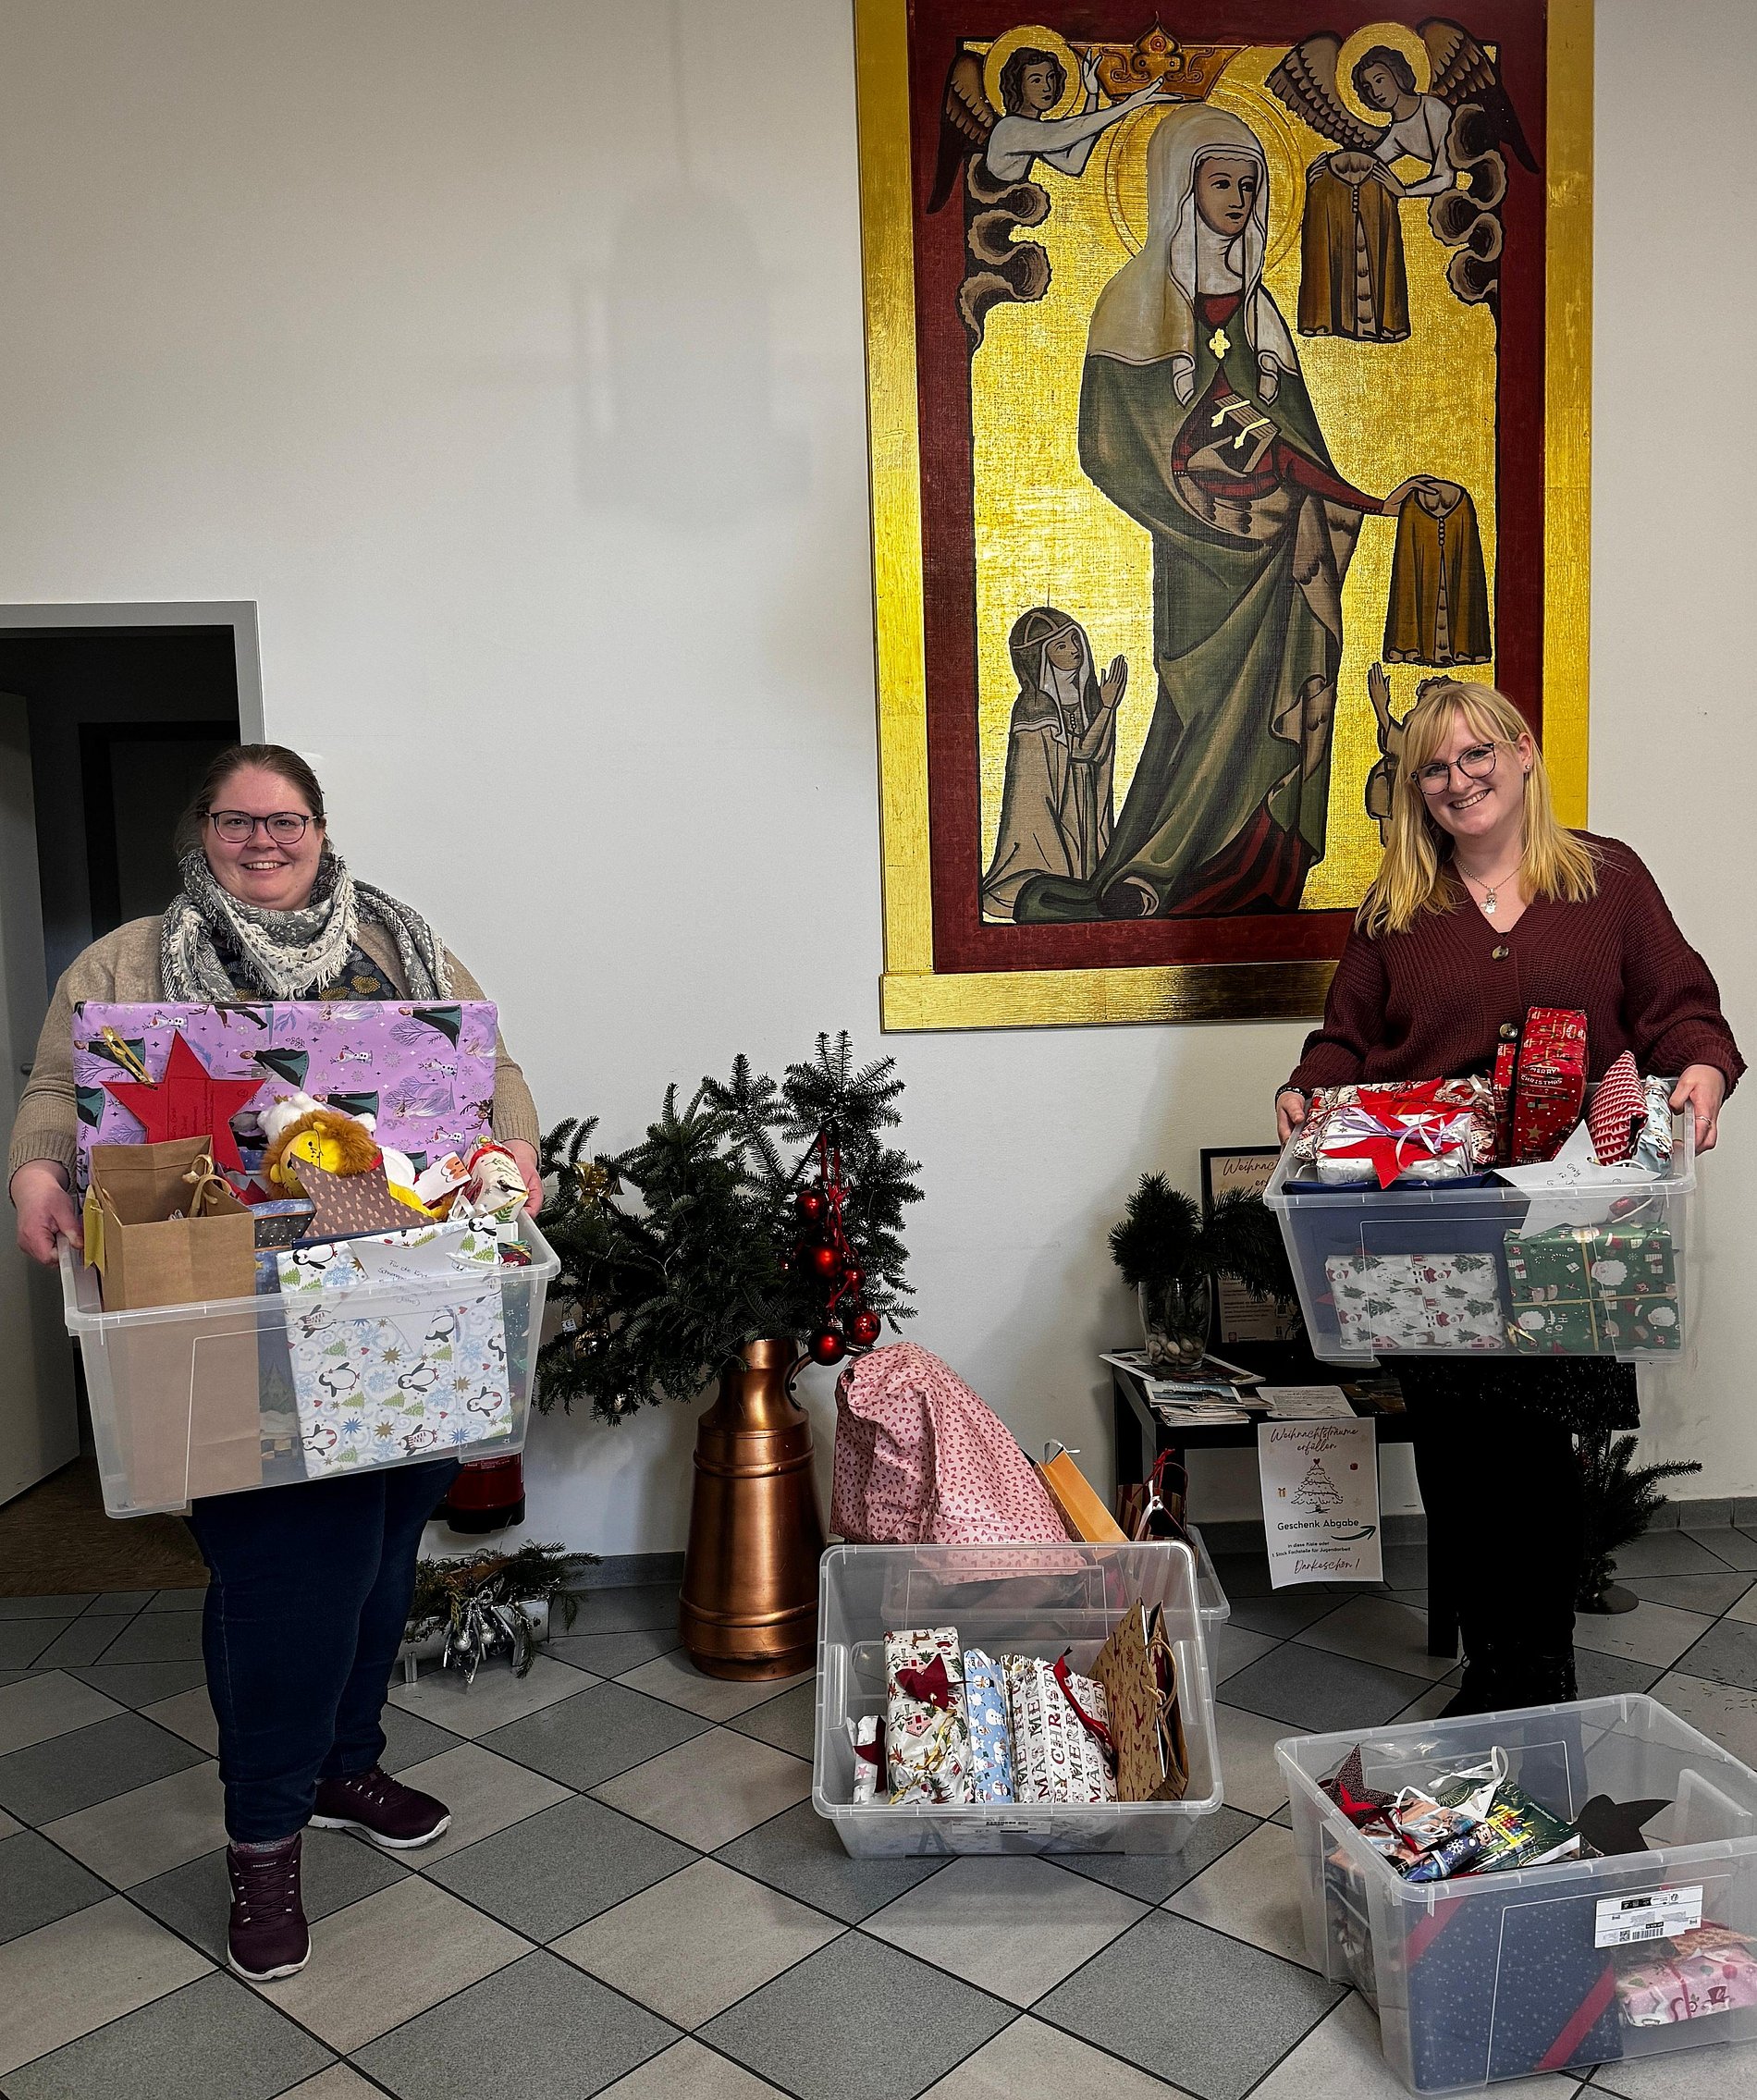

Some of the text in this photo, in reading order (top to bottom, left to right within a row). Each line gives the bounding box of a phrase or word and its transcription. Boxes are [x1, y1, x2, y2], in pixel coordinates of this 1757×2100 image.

[1520, 1075, 1563, 1086] CHRISTMAS
[1270, 1425, 1358, 1443] Weihnachtsträume
[1296, 1439, 1337, 1455] erfüllen
[1277, 1518, 1359, 1530] Geschenk Abgabe
[1024, 1672, 1043, 1738] MERR
[1042, 1663, 1065, 1765] CHRISTM
